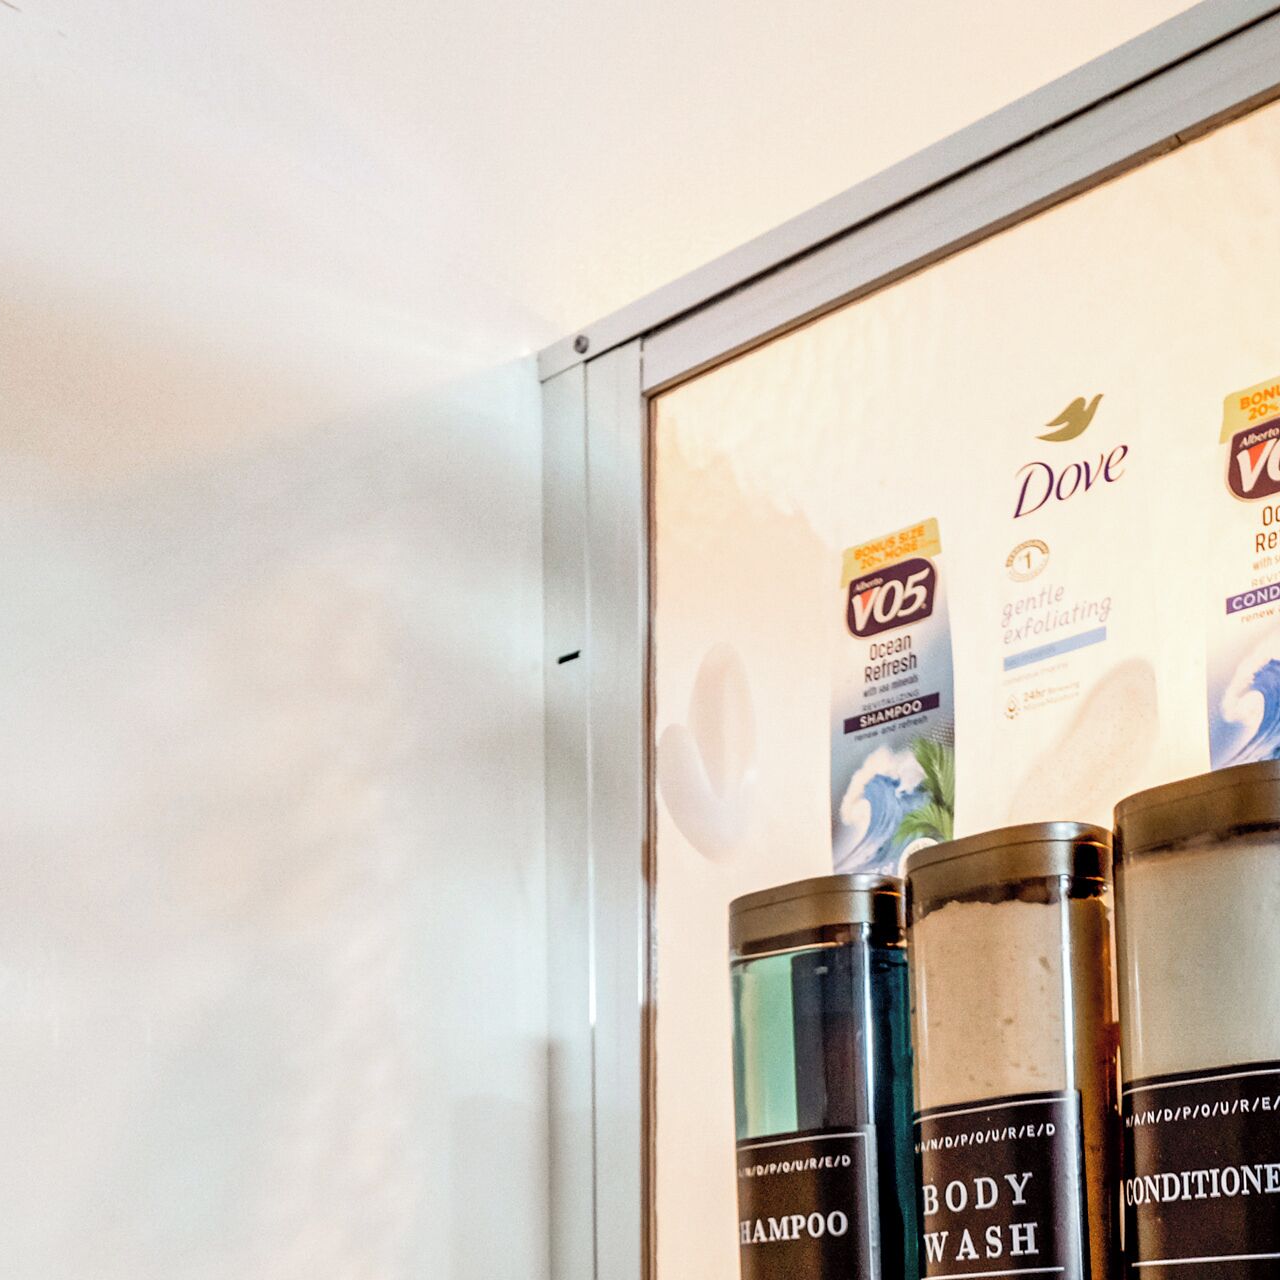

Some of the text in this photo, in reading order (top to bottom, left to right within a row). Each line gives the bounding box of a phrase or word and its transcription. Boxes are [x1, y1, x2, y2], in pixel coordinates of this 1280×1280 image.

[1239, 427, 1280, 448] Alberto
[1012, 444, 1130, 519] Dove
[854, 536, 896, 560] BONUS
[1252, 555, 1273, 571] with
[851, 567, 930, 632] VO5
[1001, 583, 1065, 628] gentle
[1002, 596, 1112, 645] exfoliating
[1240, 609, 1275, 623] renew
[869, 634, 912, 661] Ocean
[864, 652, 918, 682] Refresh
[859, 699, 923, 728] SHAMPOO
[921, 1171, 1034, 1217] BODY
[739, 1210, 849, 1245] HAMPOO
[923, 1222, 1040, 1264] WASH
